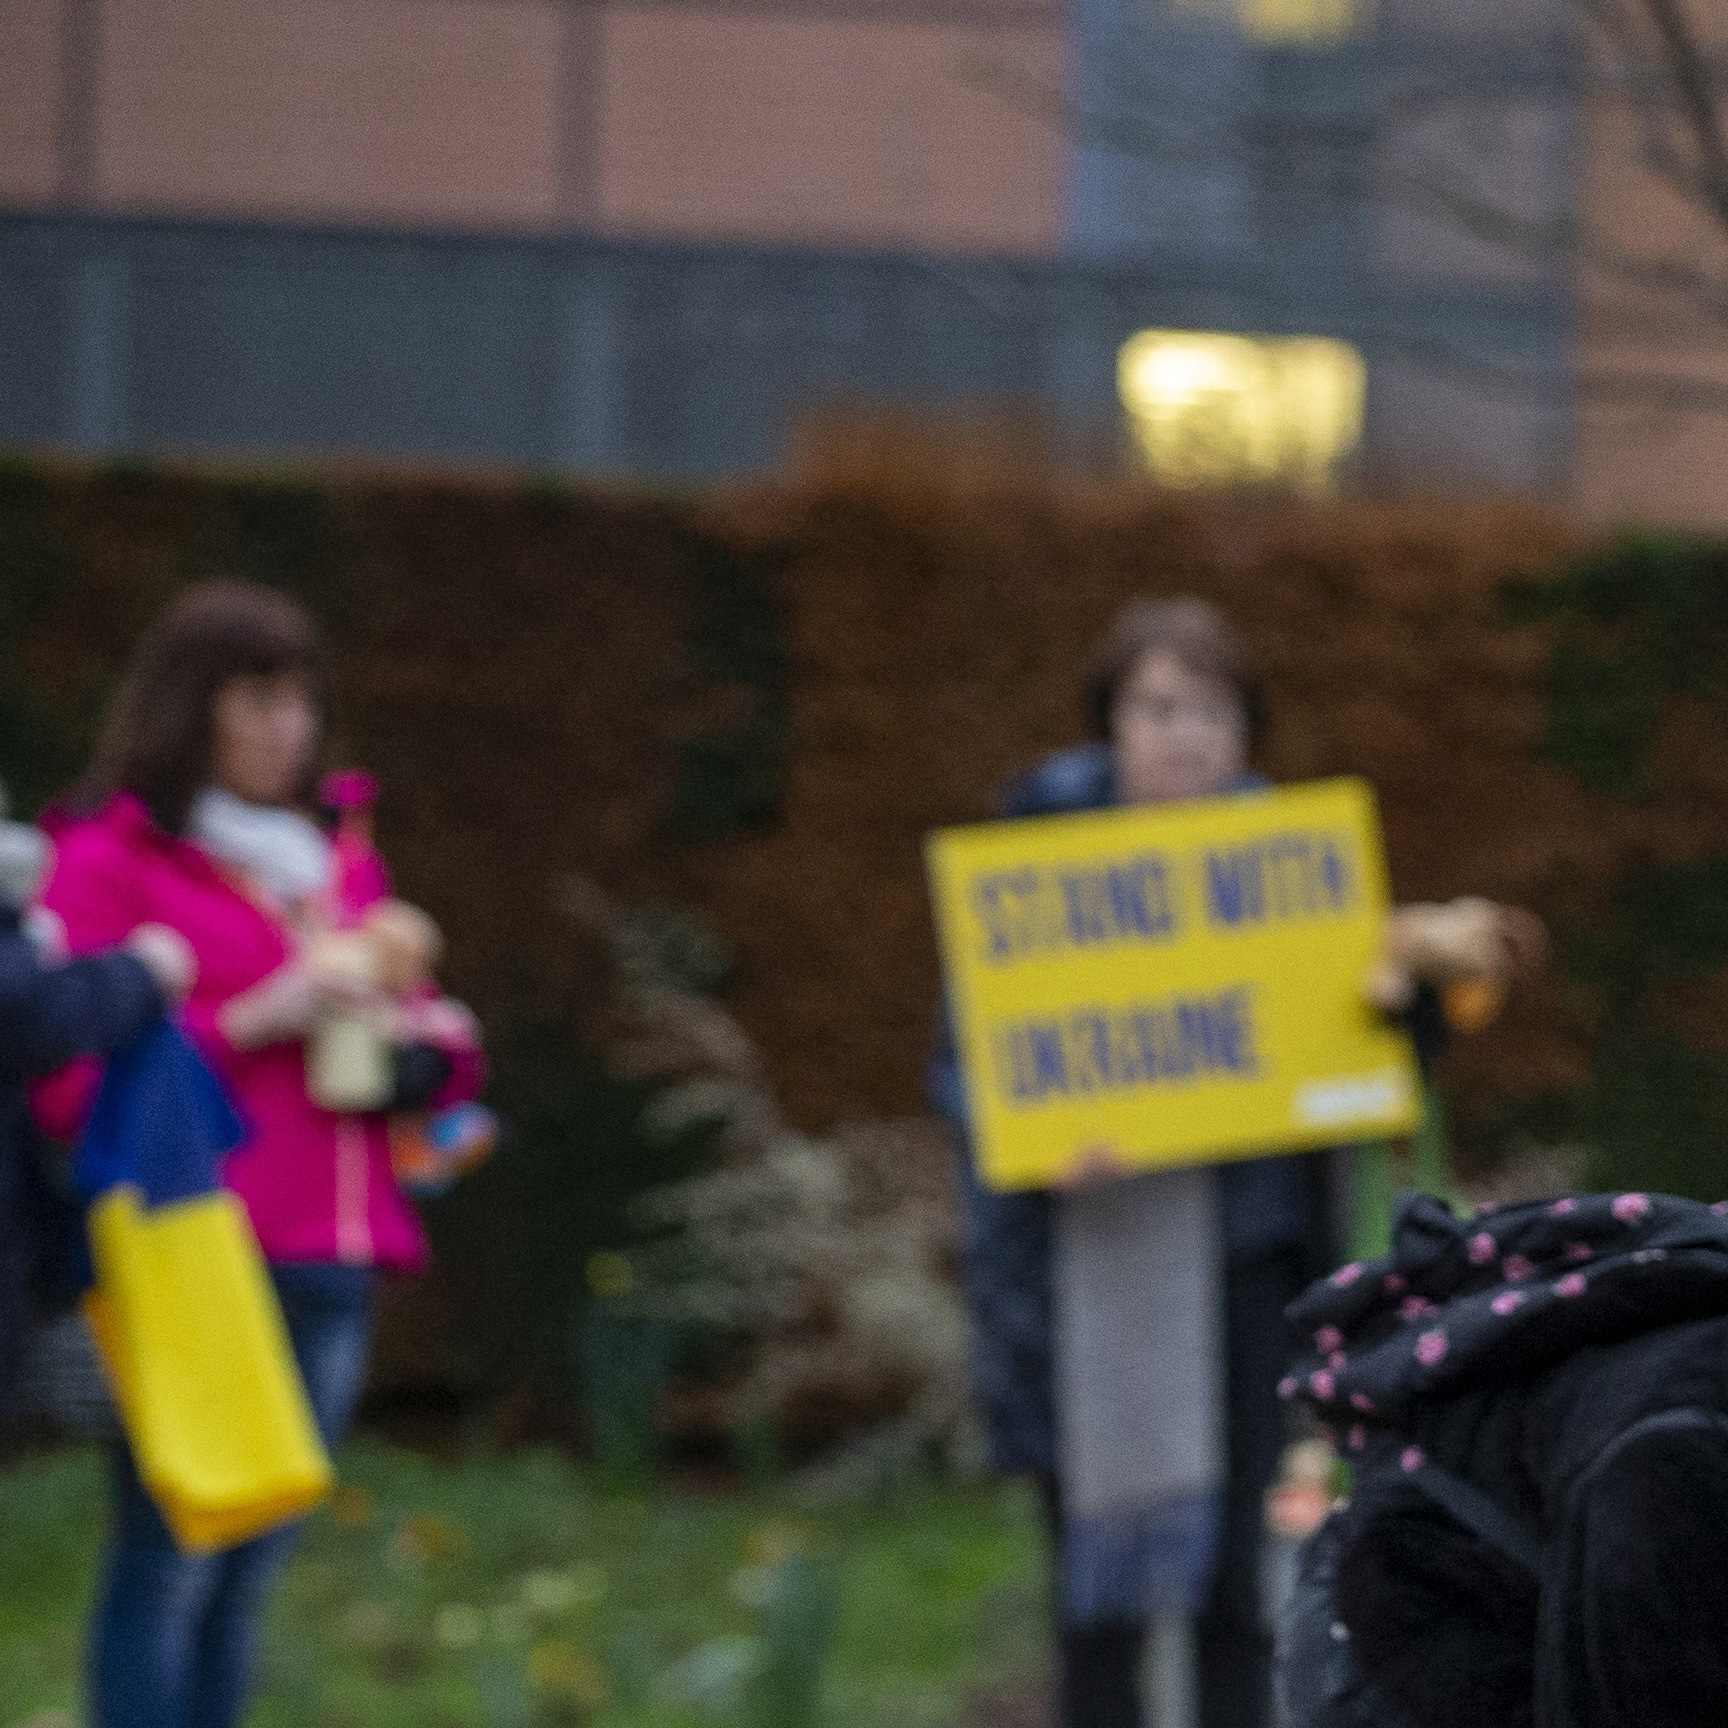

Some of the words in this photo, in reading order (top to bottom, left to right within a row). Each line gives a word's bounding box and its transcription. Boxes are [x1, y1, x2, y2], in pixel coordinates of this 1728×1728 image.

[976, 854, 1174, 964] STAND
[1205, 836, 1348, 926] WITH
[1005, 988, 1260, 1104] UKRAINE
